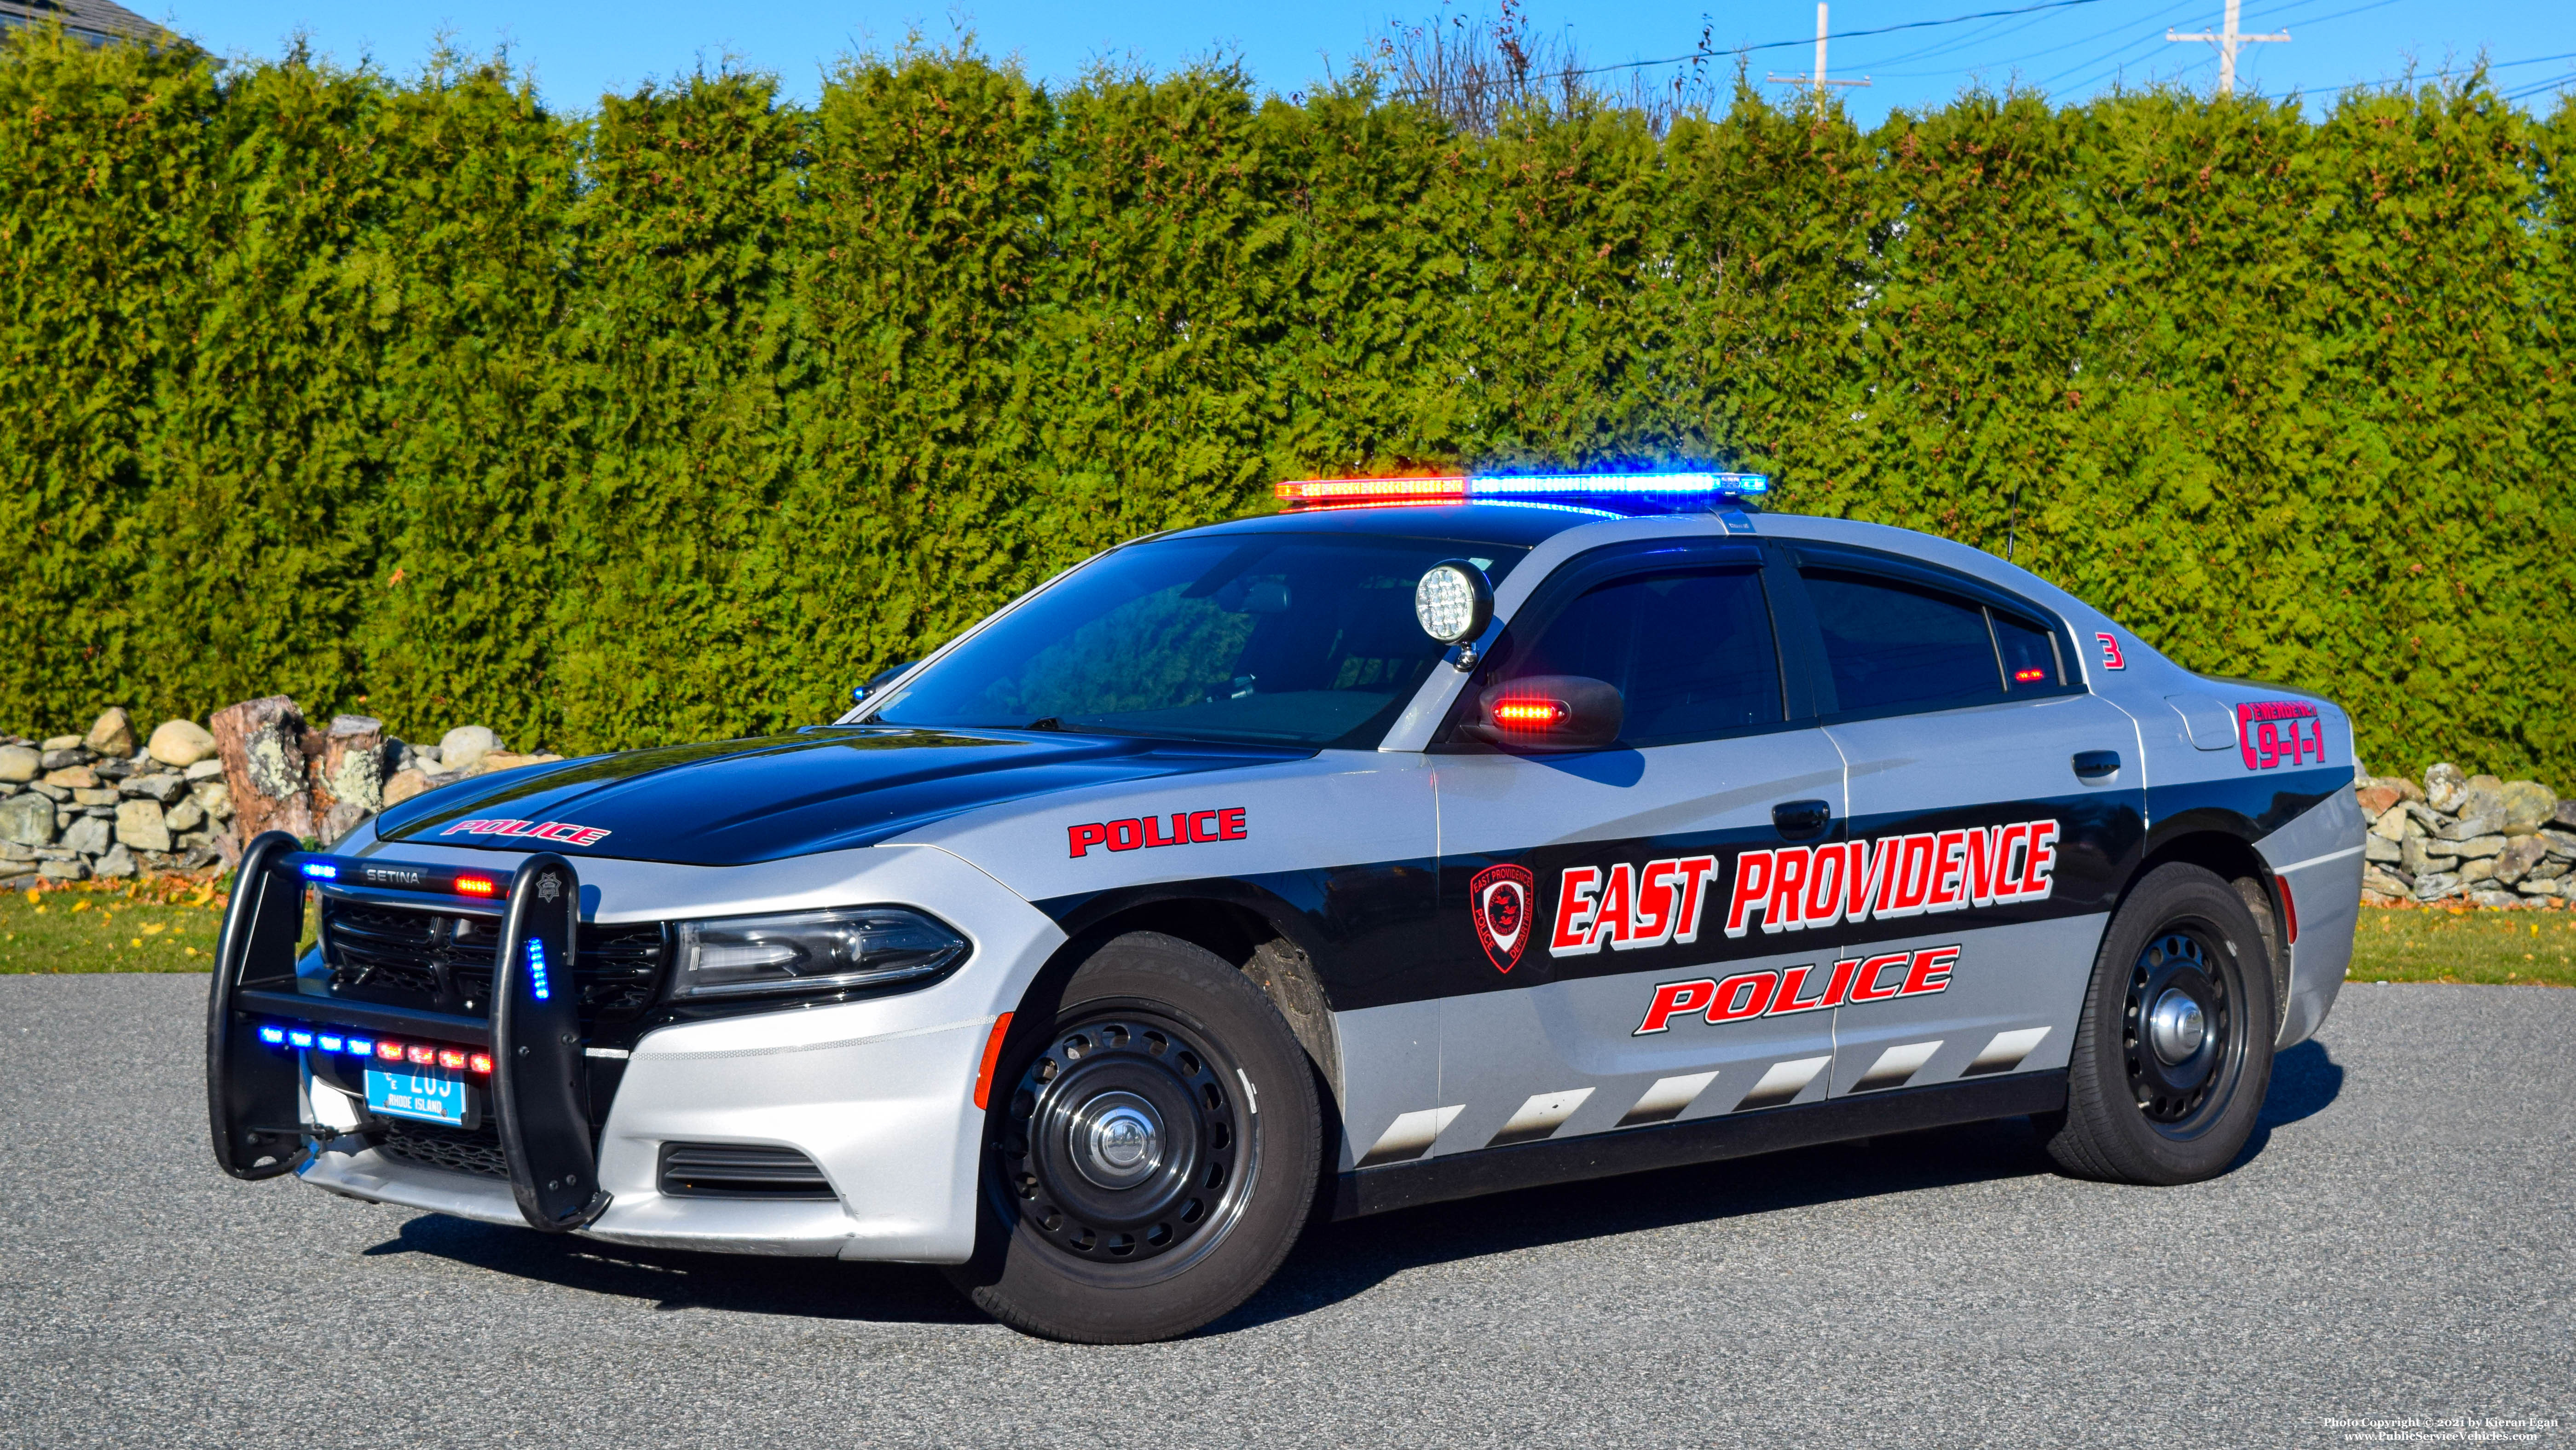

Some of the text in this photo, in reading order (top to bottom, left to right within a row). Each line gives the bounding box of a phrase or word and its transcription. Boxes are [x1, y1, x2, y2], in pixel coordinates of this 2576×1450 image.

[2095, 631, 2125, 671] 3
[2247, 701, 2318, 722] EMERGENCY
[2257, 718, 2325, 770] 9-1-1
[439, 819, 612, 847] POLICE
[1068, 806, 1248, 859] POLICE
[367, 869, 420, 884] SETINA
[1474, 868, 1531, 893] EAST PROVIDENCE
[1548, 818, 2059, 958] EAST PROVIDENCE
[1476, 908, 1495, 951] POLICE
[1509, 890, 1531, 959] DEPARTMENT
[1631, 943, 1962, 1038] POLICE
[388, 1093, 442, 1114] RHODE ISLAND
